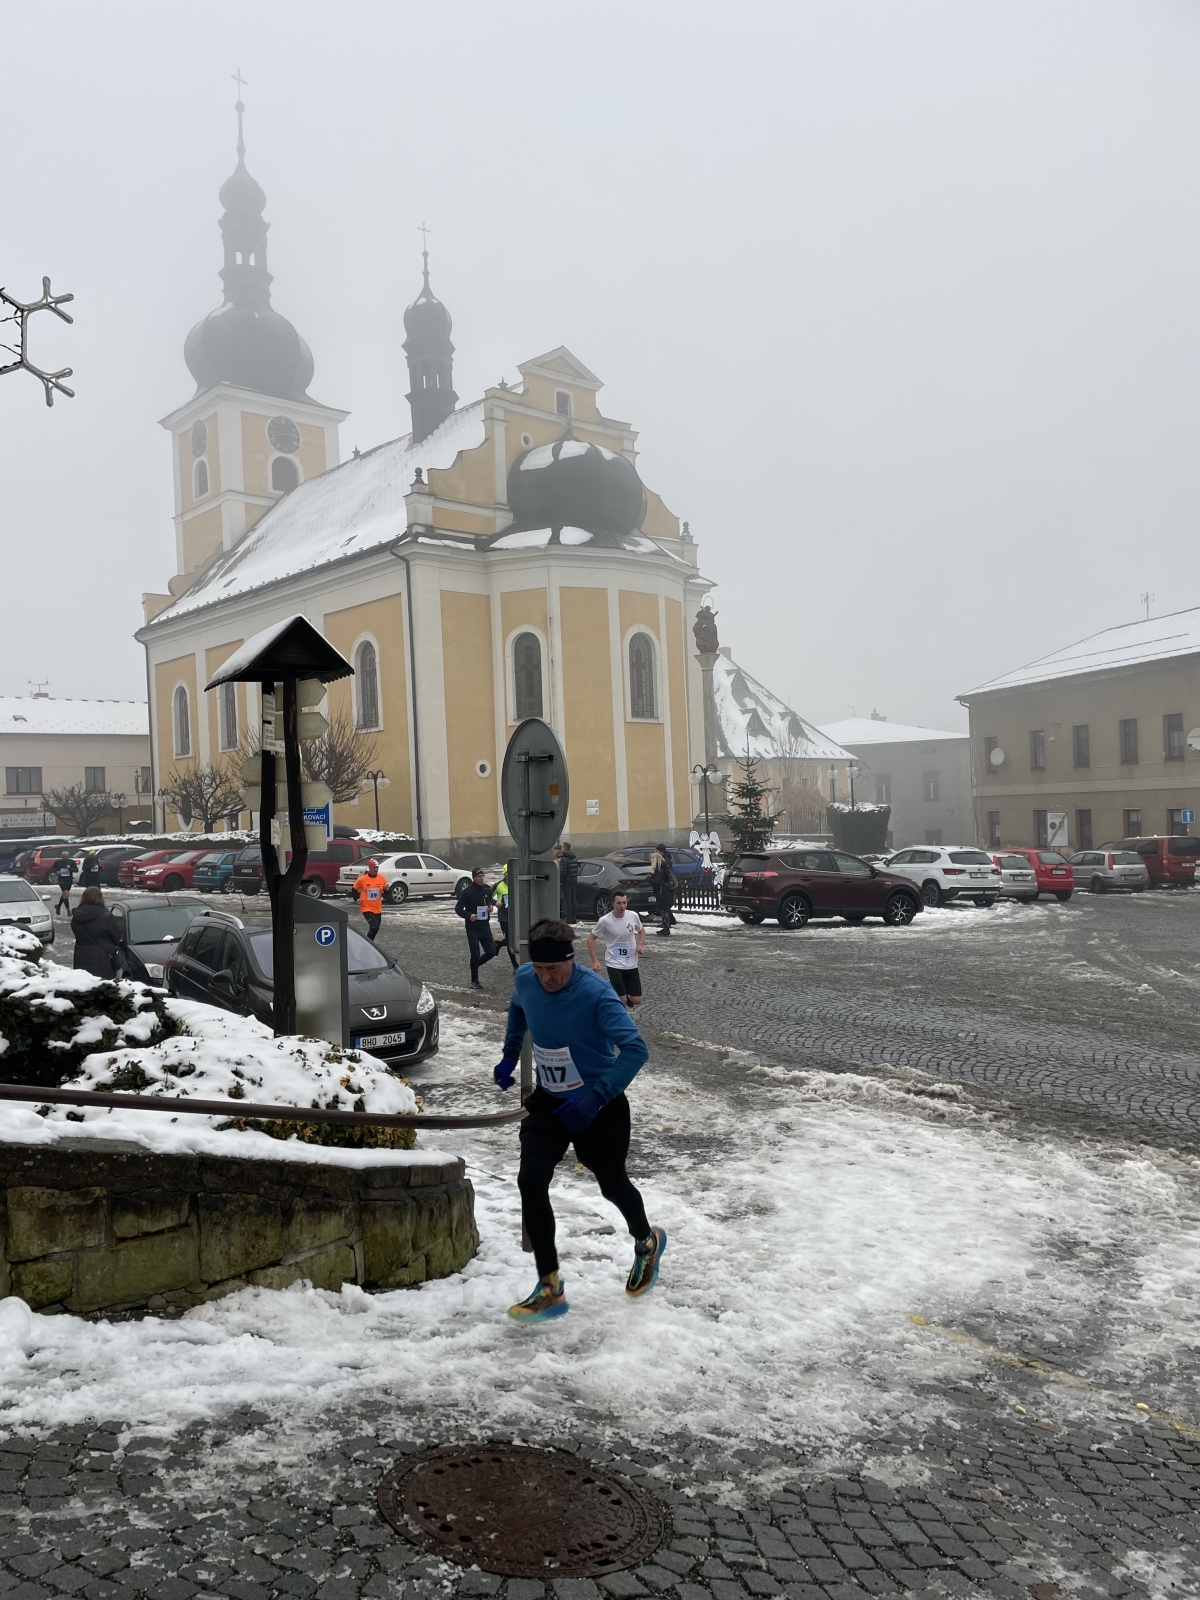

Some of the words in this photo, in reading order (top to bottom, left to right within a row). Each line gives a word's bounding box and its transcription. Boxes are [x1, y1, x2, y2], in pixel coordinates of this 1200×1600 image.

[321, 929, 331, 943] P
[618, 948, 628, 956] 19
[382, 1033, 402, 1045] 2045
[540, 1064, 567, 1084] 117
